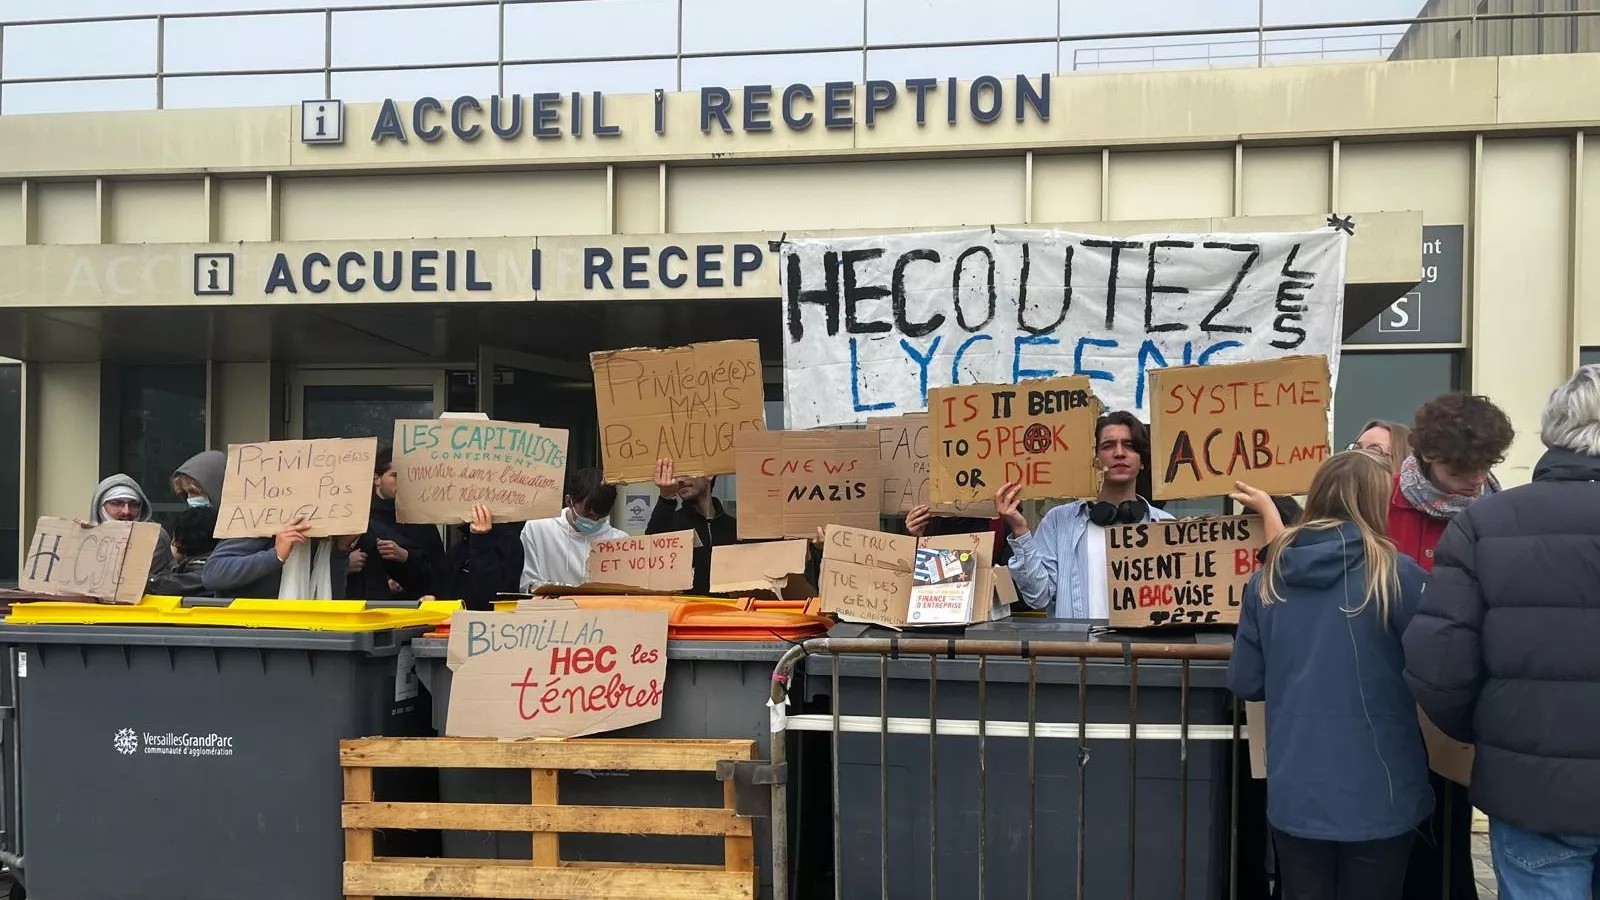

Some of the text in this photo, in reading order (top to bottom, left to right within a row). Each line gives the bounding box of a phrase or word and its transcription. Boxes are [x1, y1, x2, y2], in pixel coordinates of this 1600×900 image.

[371, 91, 620, 141] ACCUEIL
[701, 74, 1051, 133] RECEPTION
[265, 250, 492, 294] ACCUEIL
[786, 240, 1261, 342] HECOUTEZ
[1268, 244, 1317, 350] LES
[1391, 297, 1409, 327] S
[669, 387, 741, 423] MAIS
[943, 389, 1088, 428] IS IT BETTER
[1165, 380, 1320, 414] SYSTEME
[403, 424, 567, 468] LES CAPITALISTES
[604, 419, 762, 460] Pas AVEUGL
[943, 439, 969, 457] TO
[460, 463, 496, 481] dans
[760, 457, 858, 475] CNEWS
[955, 468, 985, 487] OR
[244, 475, 353, 500] Mais Pas
[419, 484, 456, 502] c'est
[227, 504, 353, 530] AVEUGLES
[597, 537, 684, 553] PASCAL VOTE.
[832, 530, 896, 550] CE TRUC
[1110, 524, 1149, 548] LES
[601, 559, 621, 572] ET
[853, 552, 875, 566] LA
[1195, 551, 1216, 577] LE
[829, 570, 898, 594] TUE DES
[843, 594, 888, 612] GENS
[1113, 587, 1136, 610] LA
[1139, 583, 1173, 607] BAC
[1229, 583, 1248, 606] L
[631, 644, 659, 664] les
[144, 747, 233, 757] communauté d'agglomération
